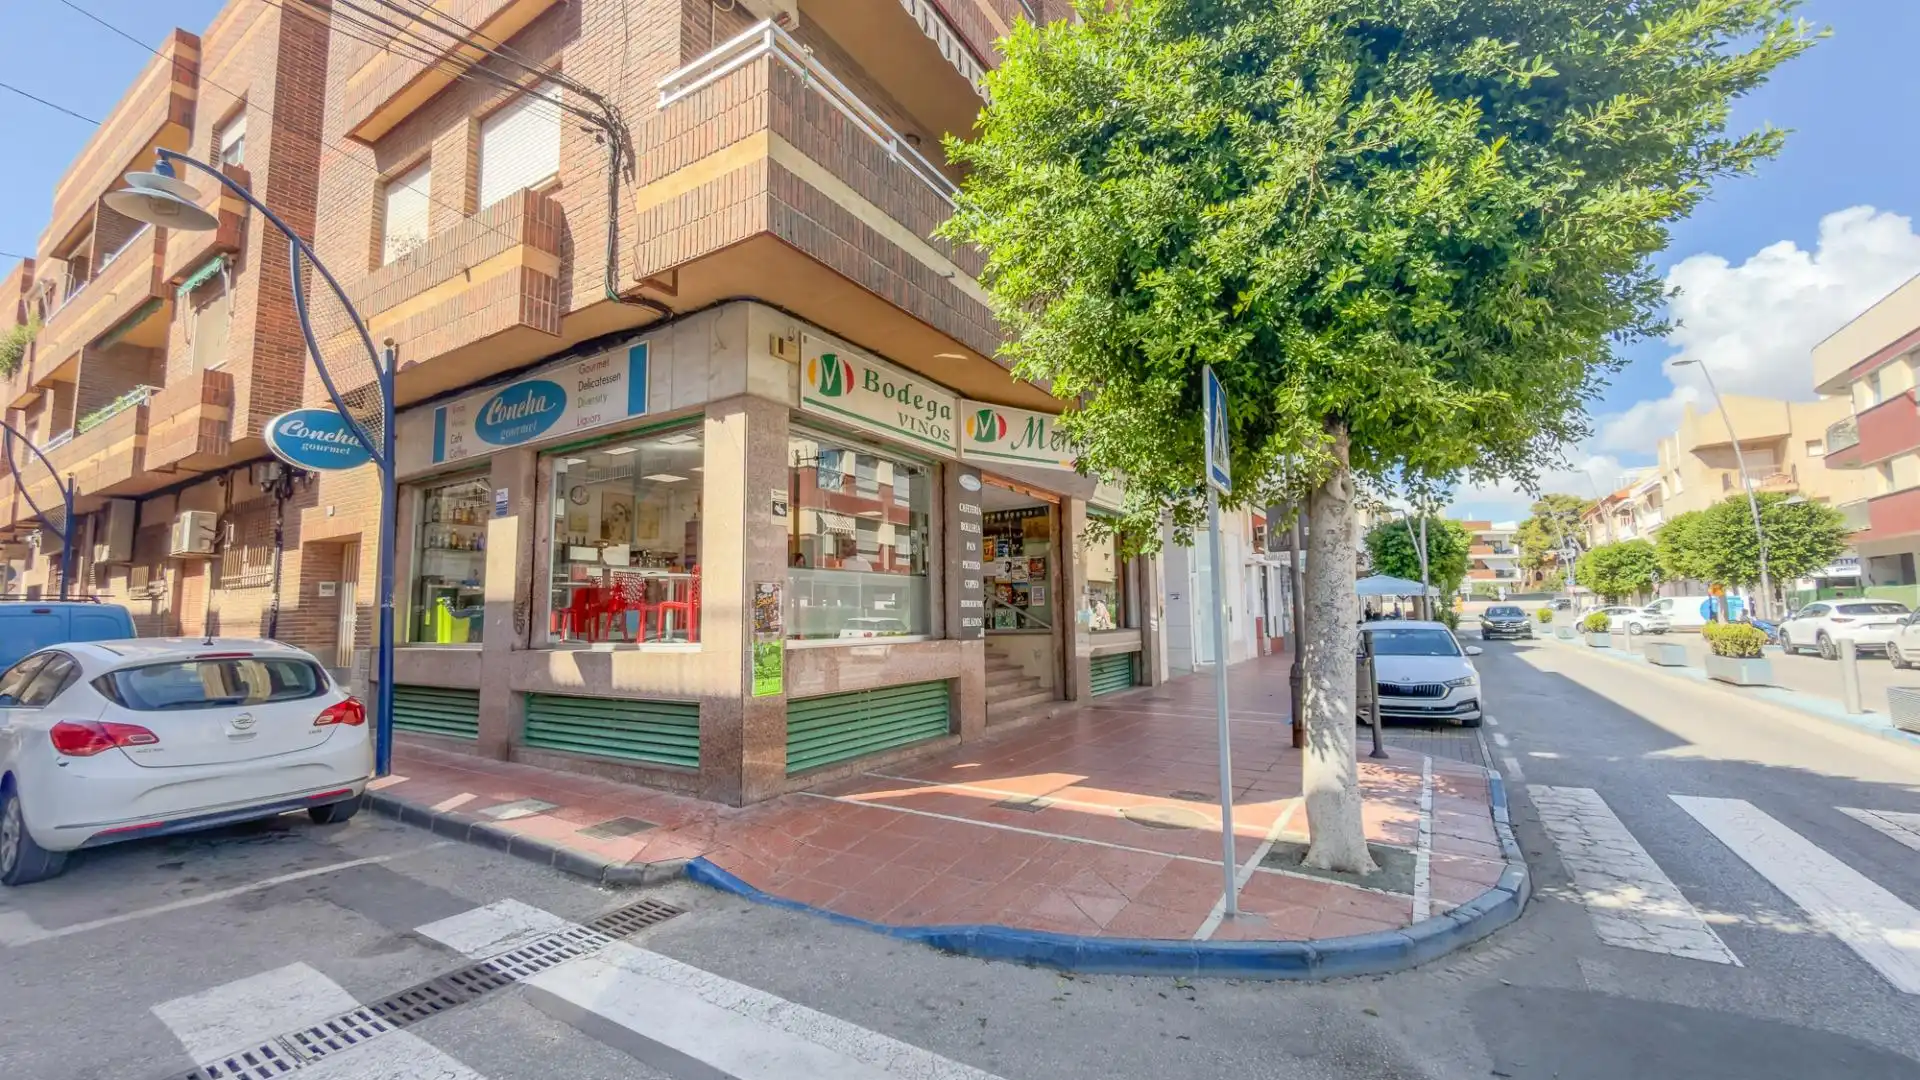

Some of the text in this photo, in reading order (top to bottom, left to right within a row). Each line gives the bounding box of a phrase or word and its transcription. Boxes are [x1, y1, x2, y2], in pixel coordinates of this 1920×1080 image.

[578, 357, 610, 375] Gourmet
[578, 372, 621, 392] Delicatessen
[862, 368, 952, 421] Bodega
[486, 388, 556, 426] Concha
[280, 420, 364, 448] Concha
[501, 420, 538, 440] gourmet
[898, 412, 951, 442] VINOS
[302, 442, 351, 455] gourmet
